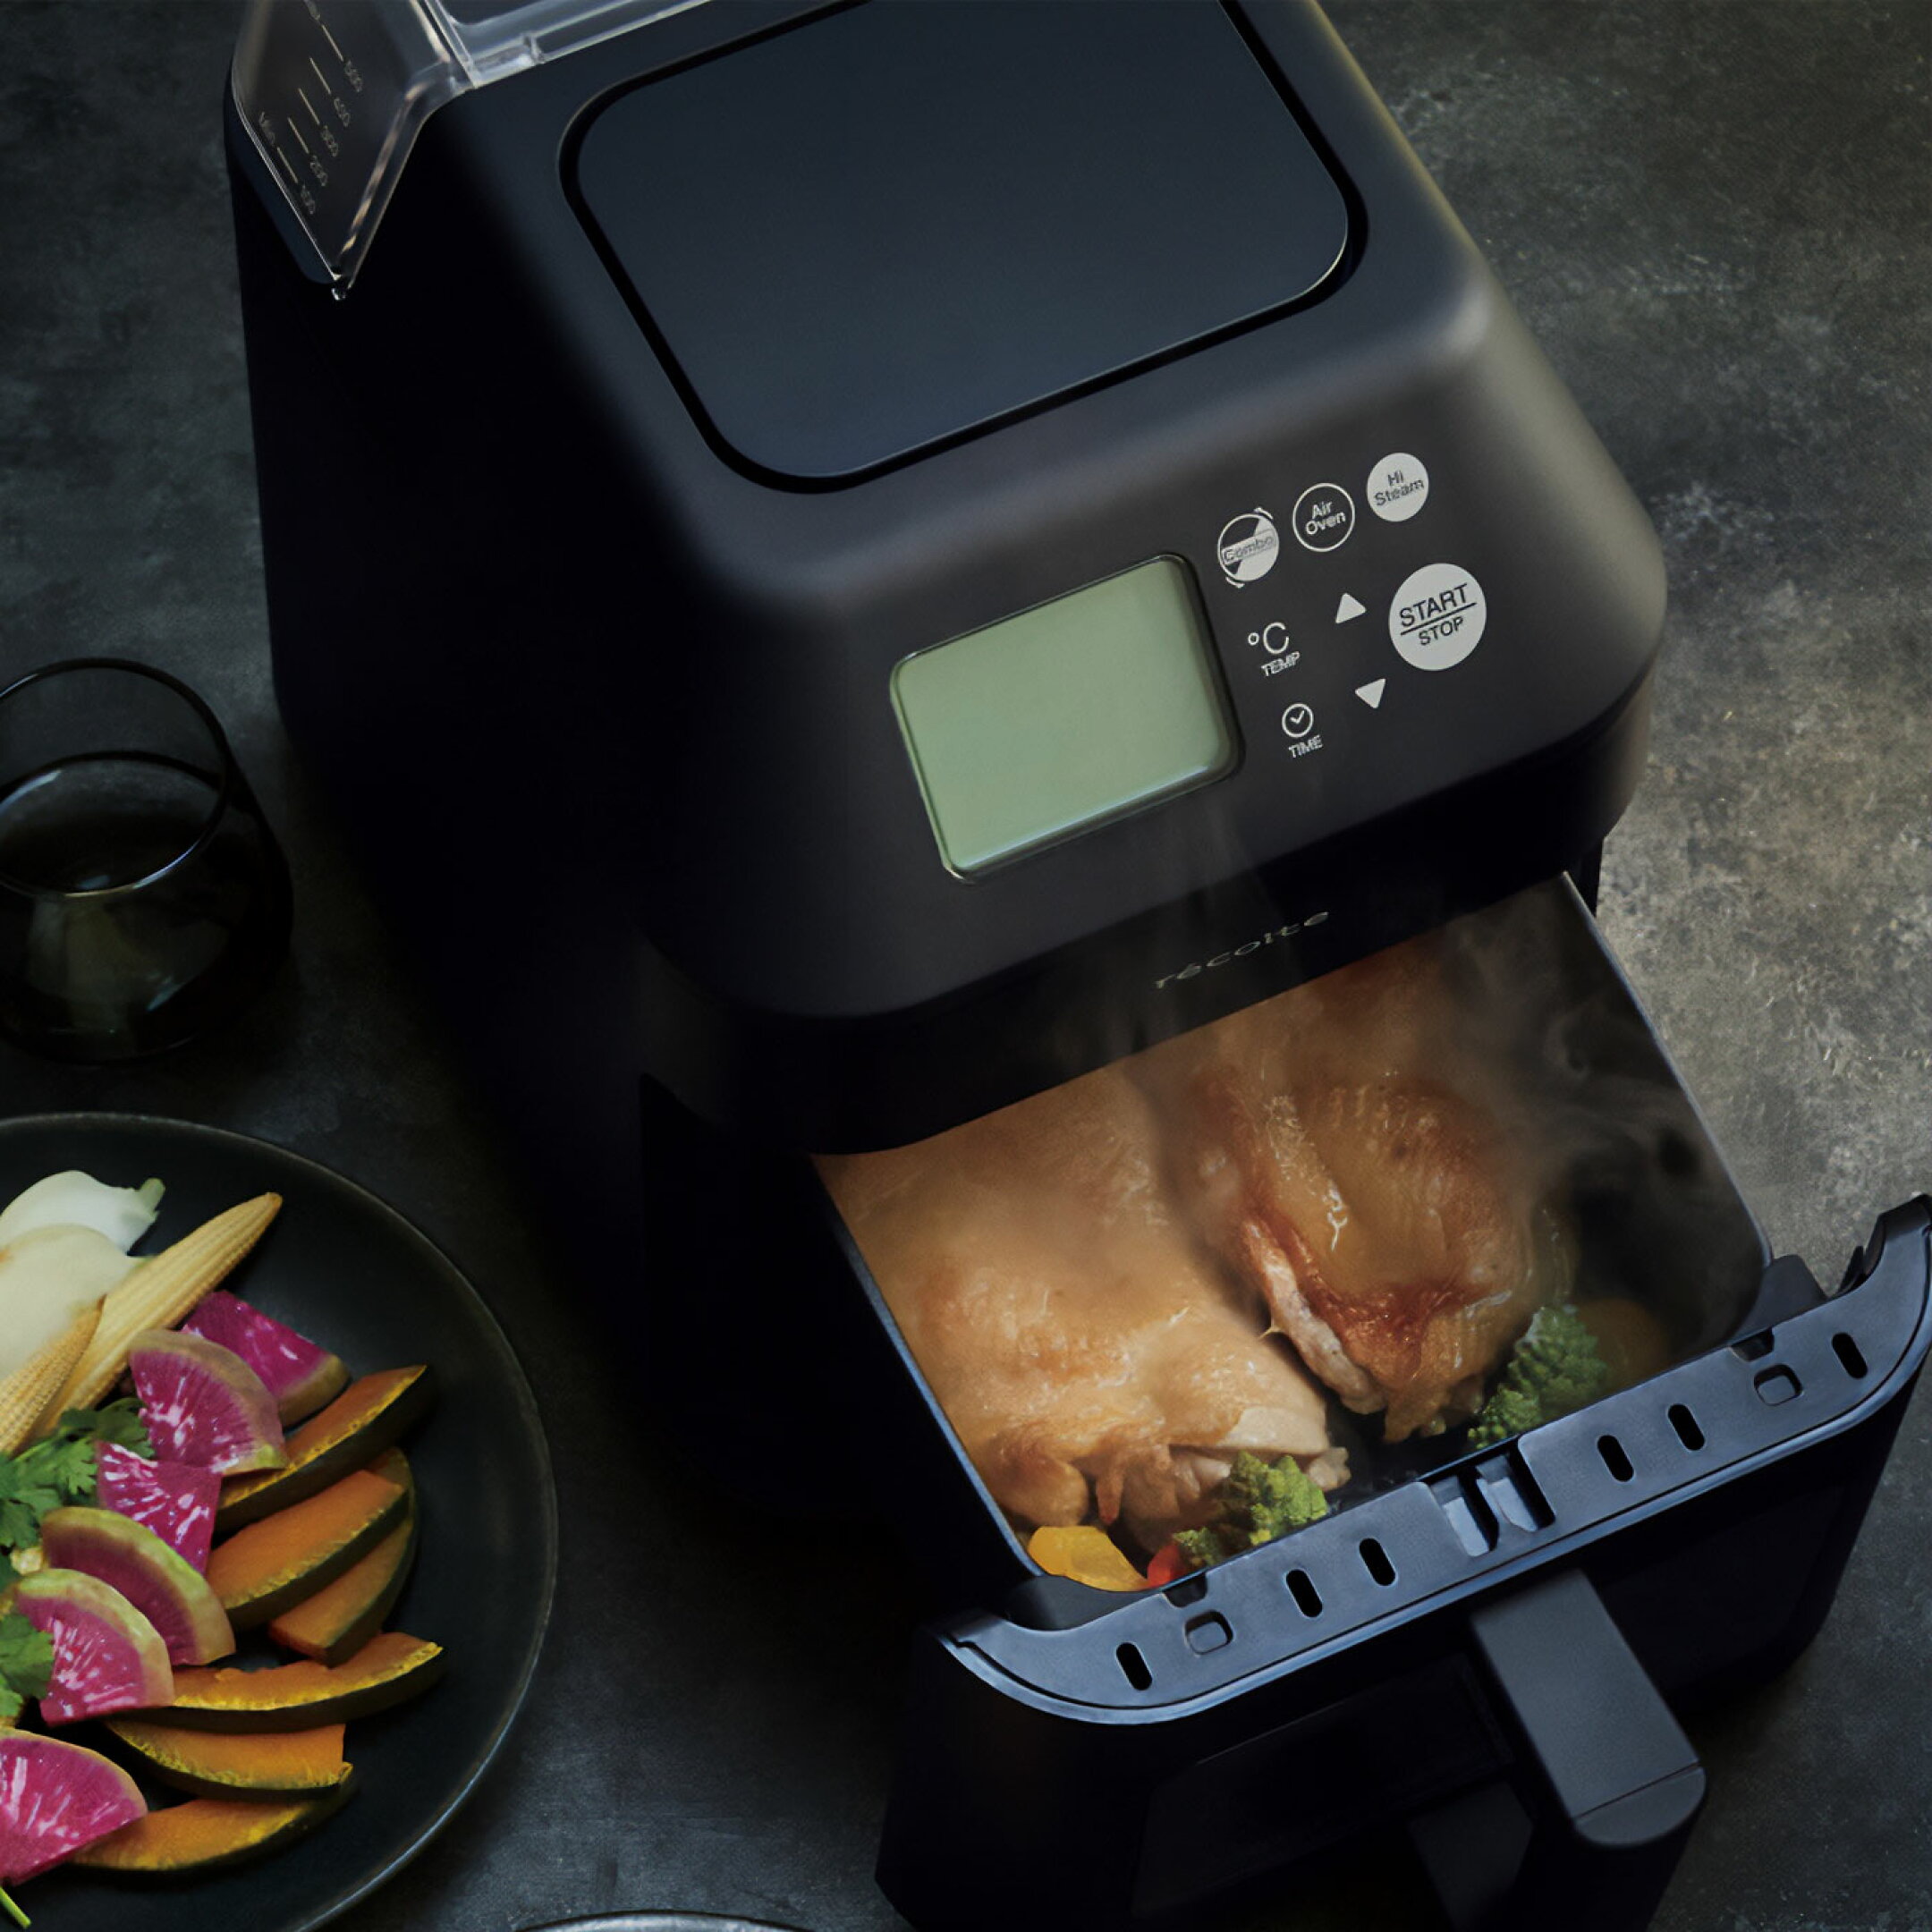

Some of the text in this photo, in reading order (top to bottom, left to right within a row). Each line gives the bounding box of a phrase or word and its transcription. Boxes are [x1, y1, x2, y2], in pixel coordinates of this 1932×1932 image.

[1387, 470, 1404, 486] Hi
[1374, 478, 1425, 507] Steam
[1305, 512, 1346, 535] Oven
[1311, 501, 1333, 520] Air
[1223, 536, 1275, 563] Combo
[1399, 582, 1469, 627] START
[1419, 616, 1464, 646] STOP
[1261, 651, 1301, 677] TEMP
[1288, 734, 1323, 758] TIME
